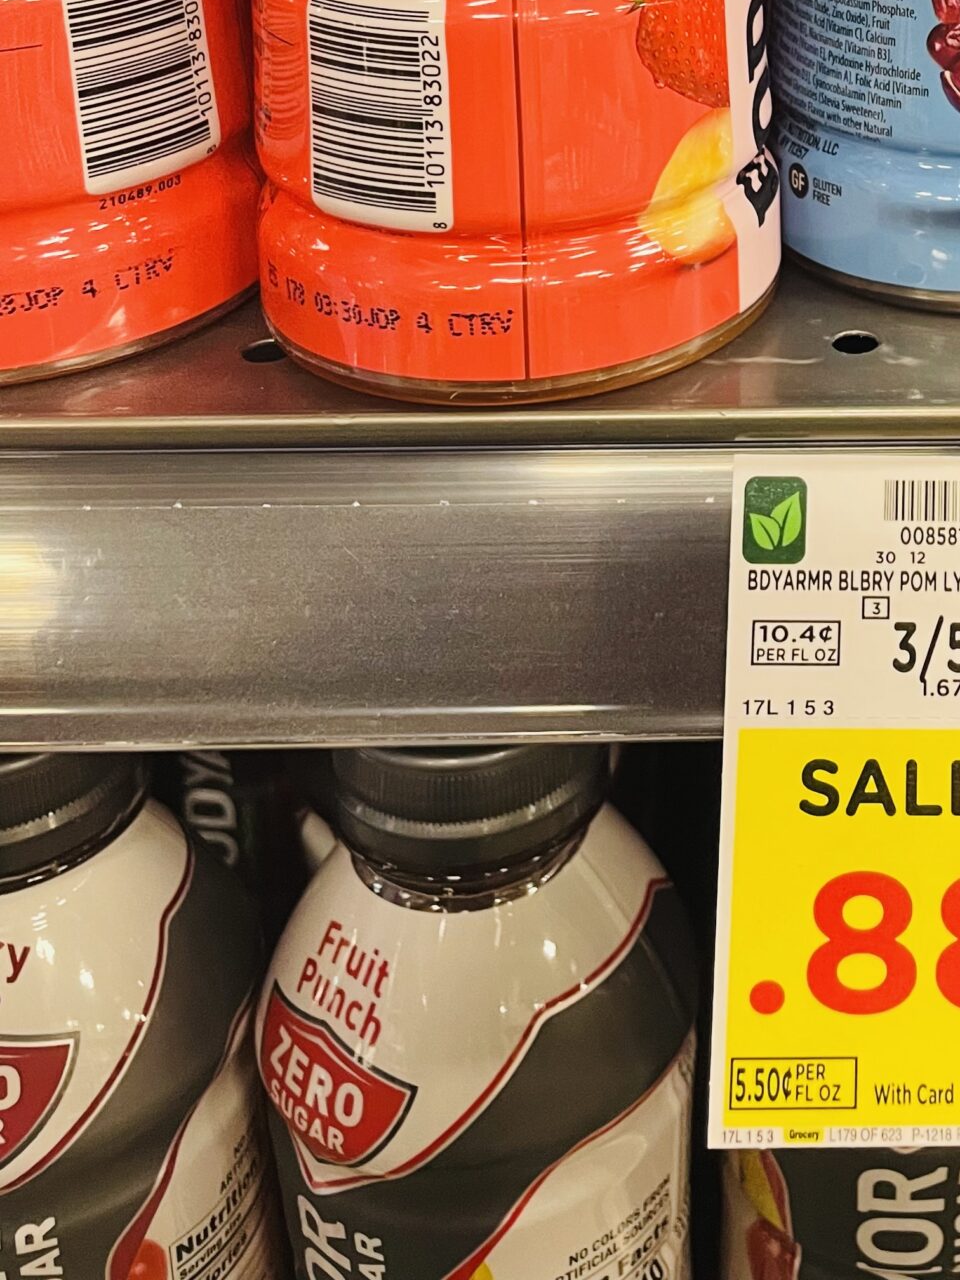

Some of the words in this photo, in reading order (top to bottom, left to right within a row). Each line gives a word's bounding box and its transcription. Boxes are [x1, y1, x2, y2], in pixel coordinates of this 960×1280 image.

[865, 30, 896, 47] Calcium
[420, 35, 442, 106] 83022
[865, 60, 921, 81] Hydrochloride
[192, 51, 213, 117] 10113
[425, 120, 445, 187] 10113
[100, 174, 182, 210] 210489.003
[812, 177, 842, 197] GLUTEN
[876, 551, 896, 564] 30
[910, 551, 926, 564] 12
[748, 570, 832, 591] BDYARMR
[838, 570, 894, 592] BLBRY
[900, 573, 937, 592] POM
[759, 624, 832, 644] 10.4¢
[756, 648, 786, 662] PER
[791, 648, 809, 662] FL
[815, 648, 837, 662] OZ
[742, 699, 778, 716] 17L
[318, 919, 390, 998] Fruit
[299, 957, 382, 1048] Punch
[268, 1023, 364, 1129] ZERO
[735, 1067, 792, 1103] 5.50¢
[795, 1063, 826, 1080] PER
[795, 1084, 813, 1101] FL
[819, 1084, 841, 1101] OZ
[874, 1082, 911, 1105] With
[917, 1082, 954, 1104] Card
[269, 1082, 346, 1155] SUGAR
[789, 1129, 819, 1142] Grocery
[829, 1127, 857, 1142] L179
[860, 1127, 878, 1142] OF
[881, 1127, 902, 1142] 623
[911, 1127, 952, 1142] P-1218
